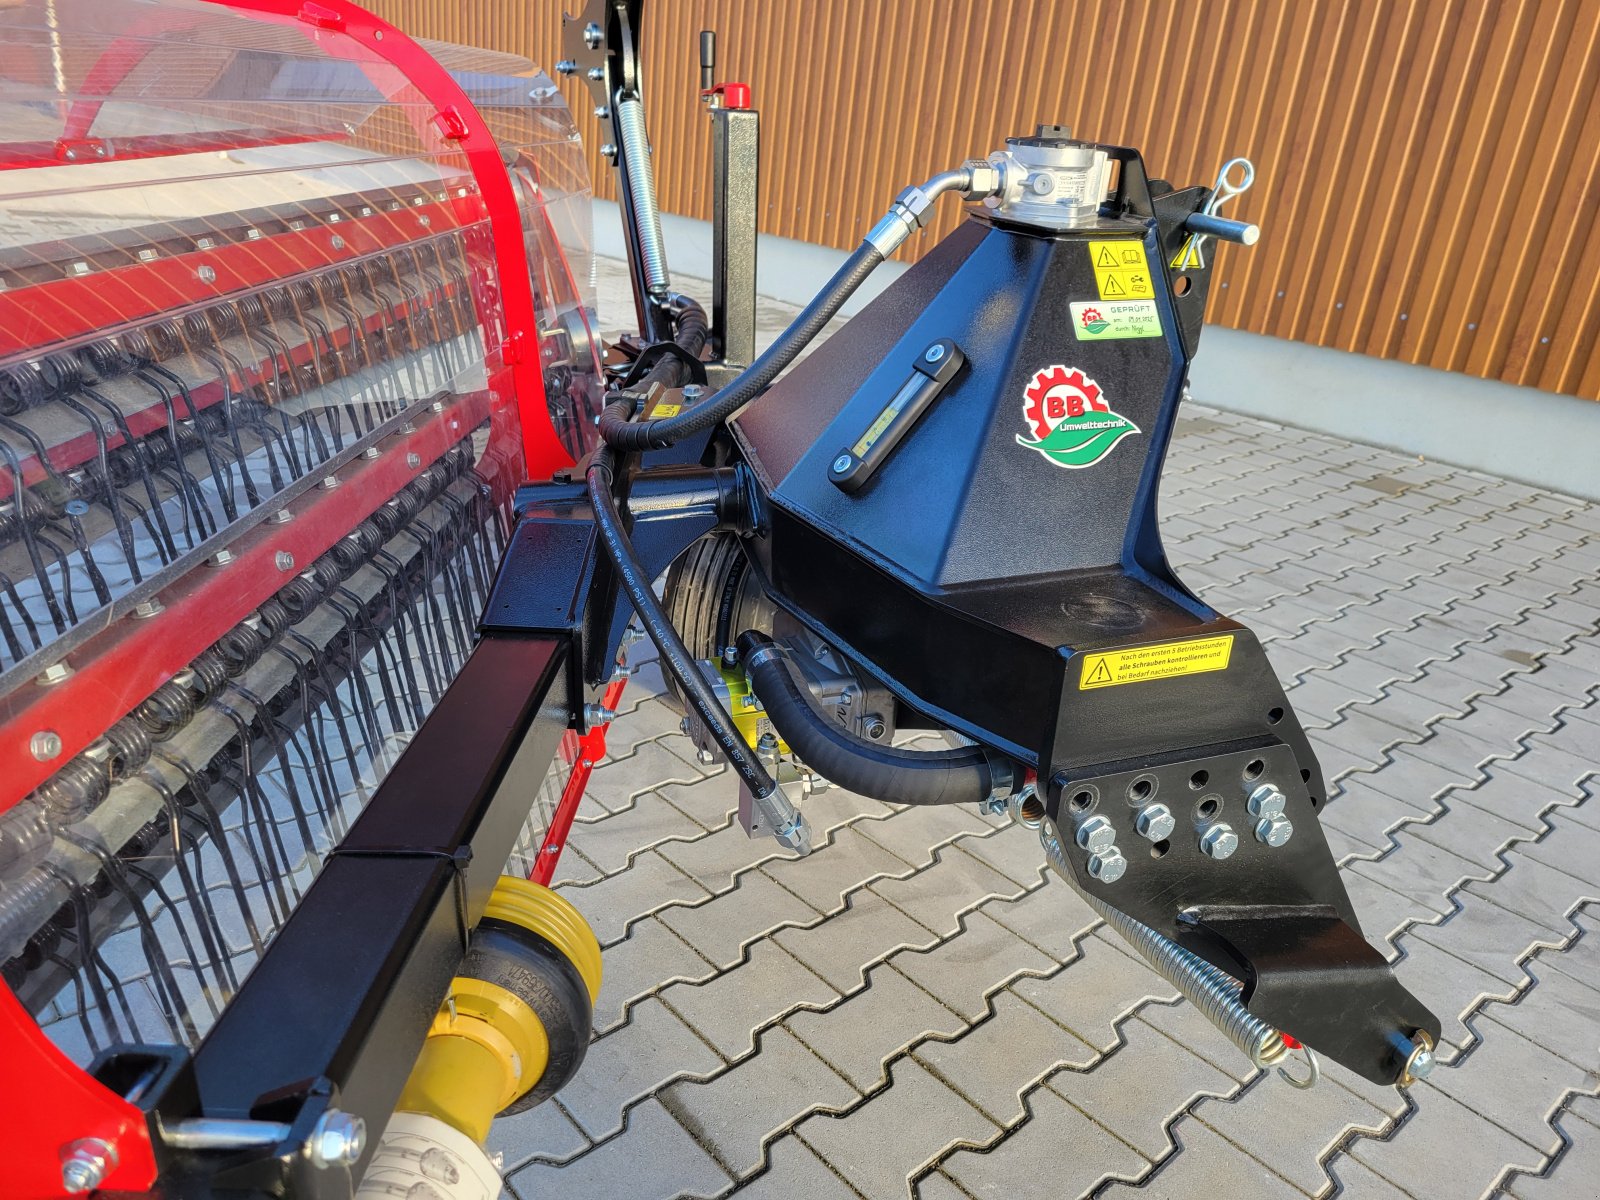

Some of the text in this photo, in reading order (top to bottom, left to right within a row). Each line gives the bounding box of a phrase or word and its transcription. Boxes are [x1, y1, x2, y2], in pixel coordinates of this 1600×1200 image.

[1110, 304, 1150, 313] GEPRÜFT
[1046, 396, 1085, 418] BB
[1059, 419, 1127, 432] Umwelttechnik
[1120, 652, 1137, 662] Nach
[1151, 649, 1171, 657] ersten
[1177, 641, 1227, 653] Betriebsstunden
[1132, 659, 1166, 669] Schrauben
[1168, 652, 1208, 664] kontrollieren
[1208, 650, 1222, 658] und
[622, 564, 634, 586] (4500
[633, 588, 646, 606] PSI)
[698, 700, 724, 735] exceeds
[722, 736, 734, 748] EN
[731, 749, 745, 763] 857
[1128, 670, 1150, 679] Bedarf
[1150, 665, 1188, 675] nachziehen!
